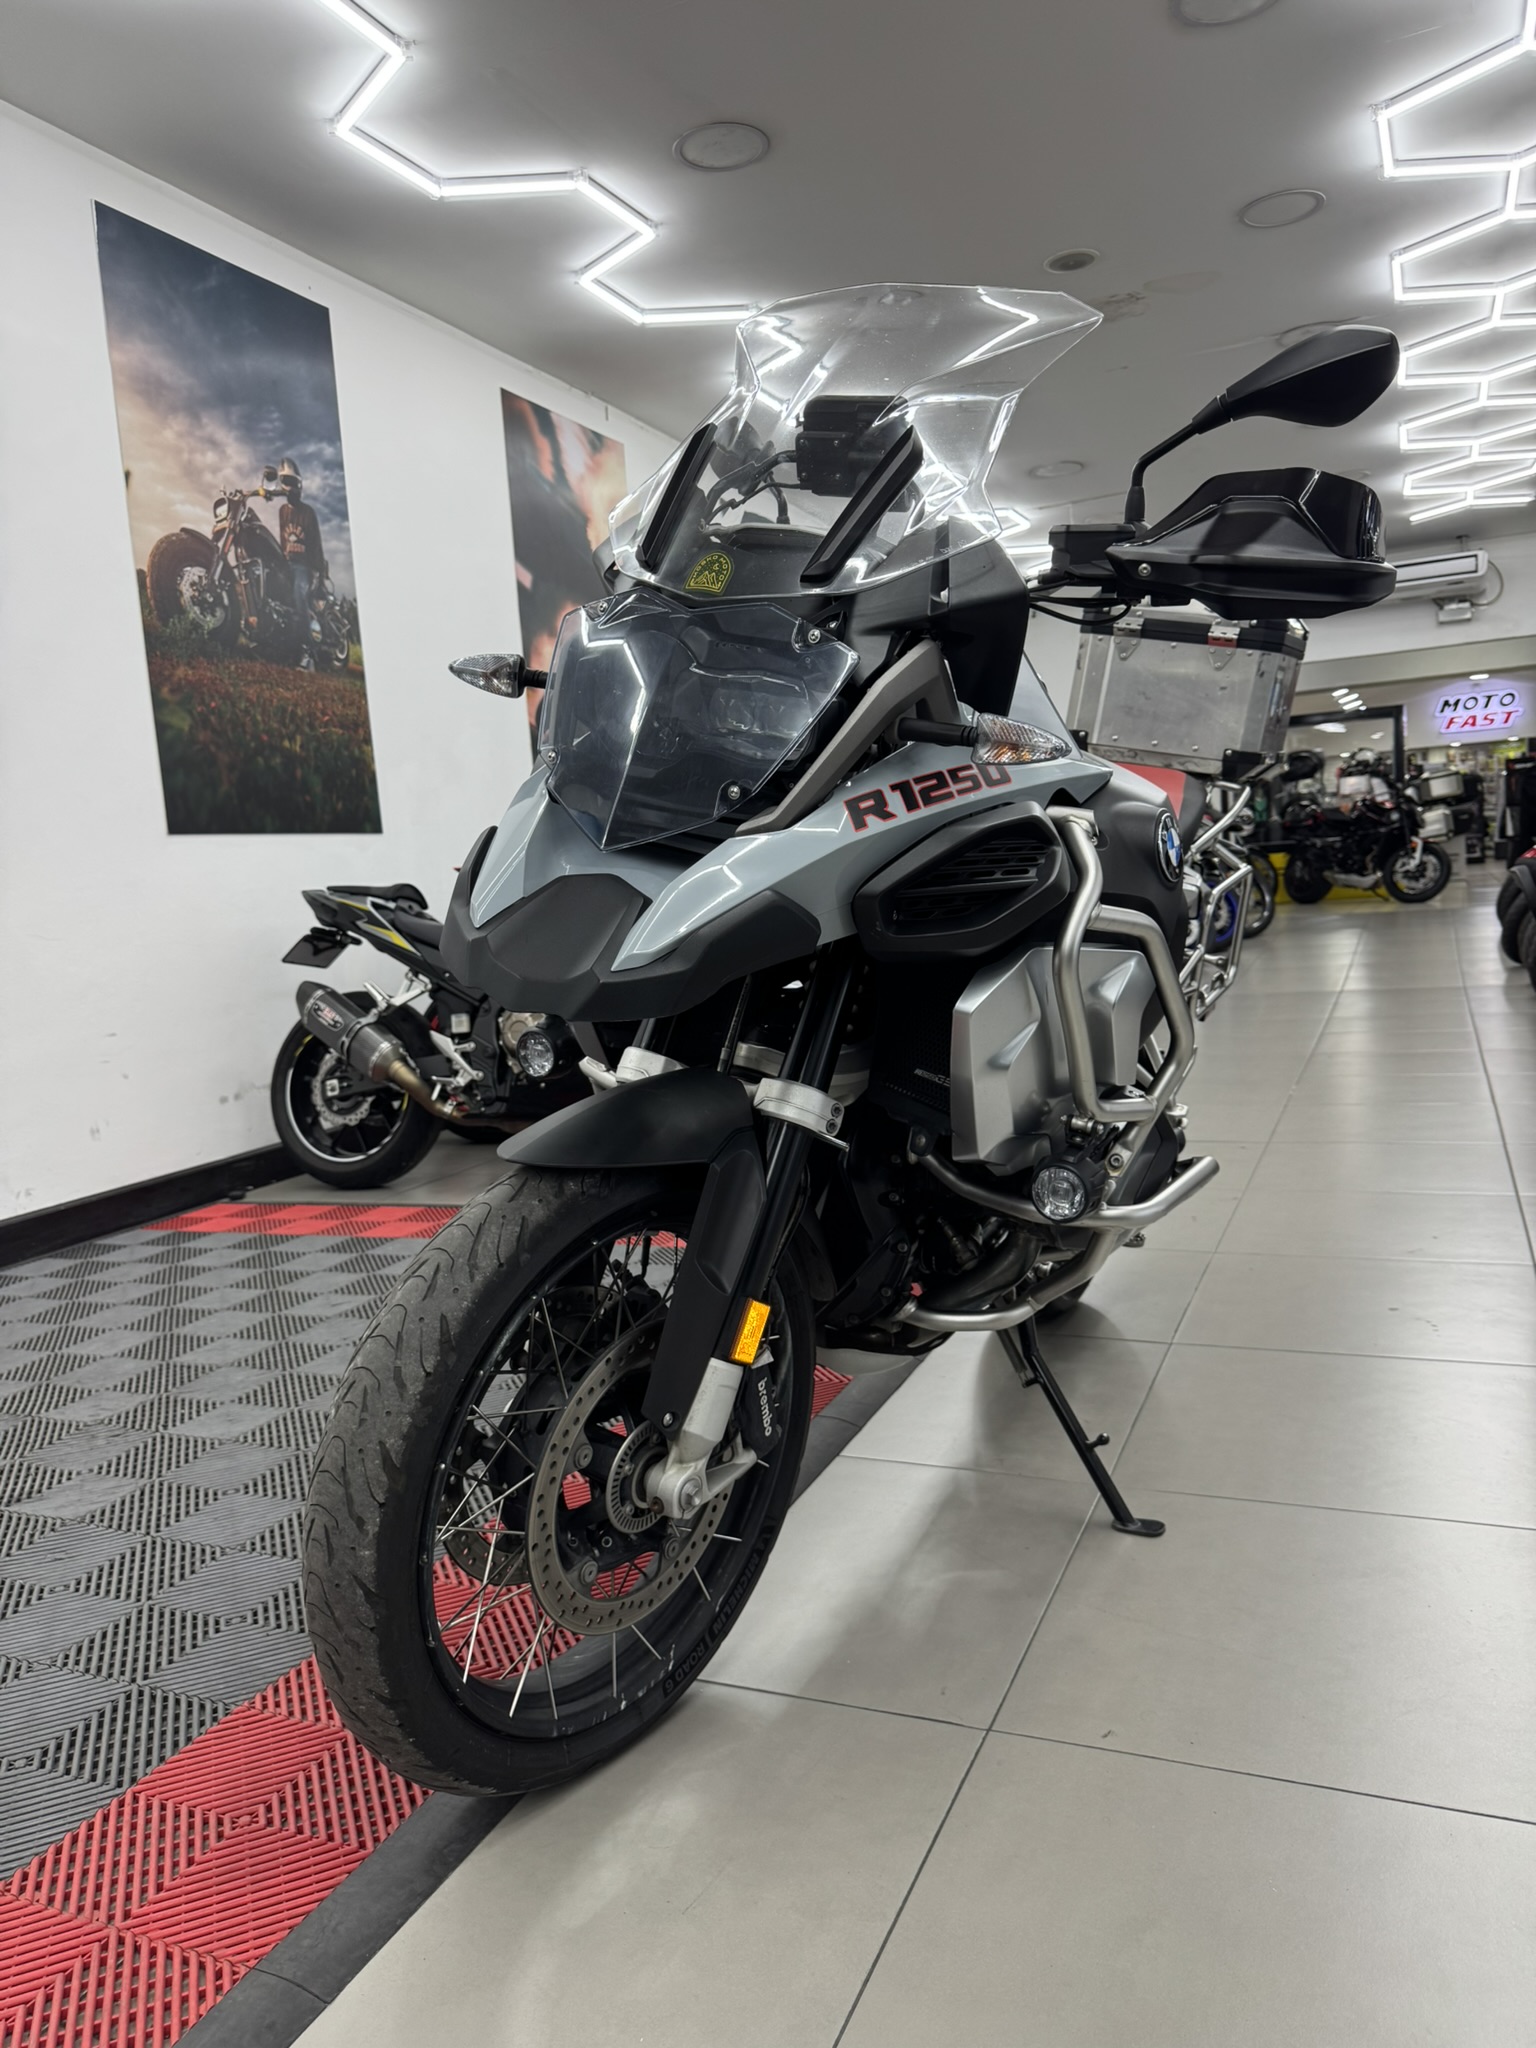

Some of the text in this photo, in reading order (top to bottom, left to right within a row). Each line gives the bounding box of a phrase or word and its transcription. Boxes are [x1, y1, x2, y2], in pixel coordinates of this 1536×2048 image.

[1439, 692, 1516, 713] MOTO
[1445, 709, 1519, 730] FAST
[757, 1376, 772, 1437] brembo
[664, 1552, 760, 1693] MICHELIN ROAD 6
